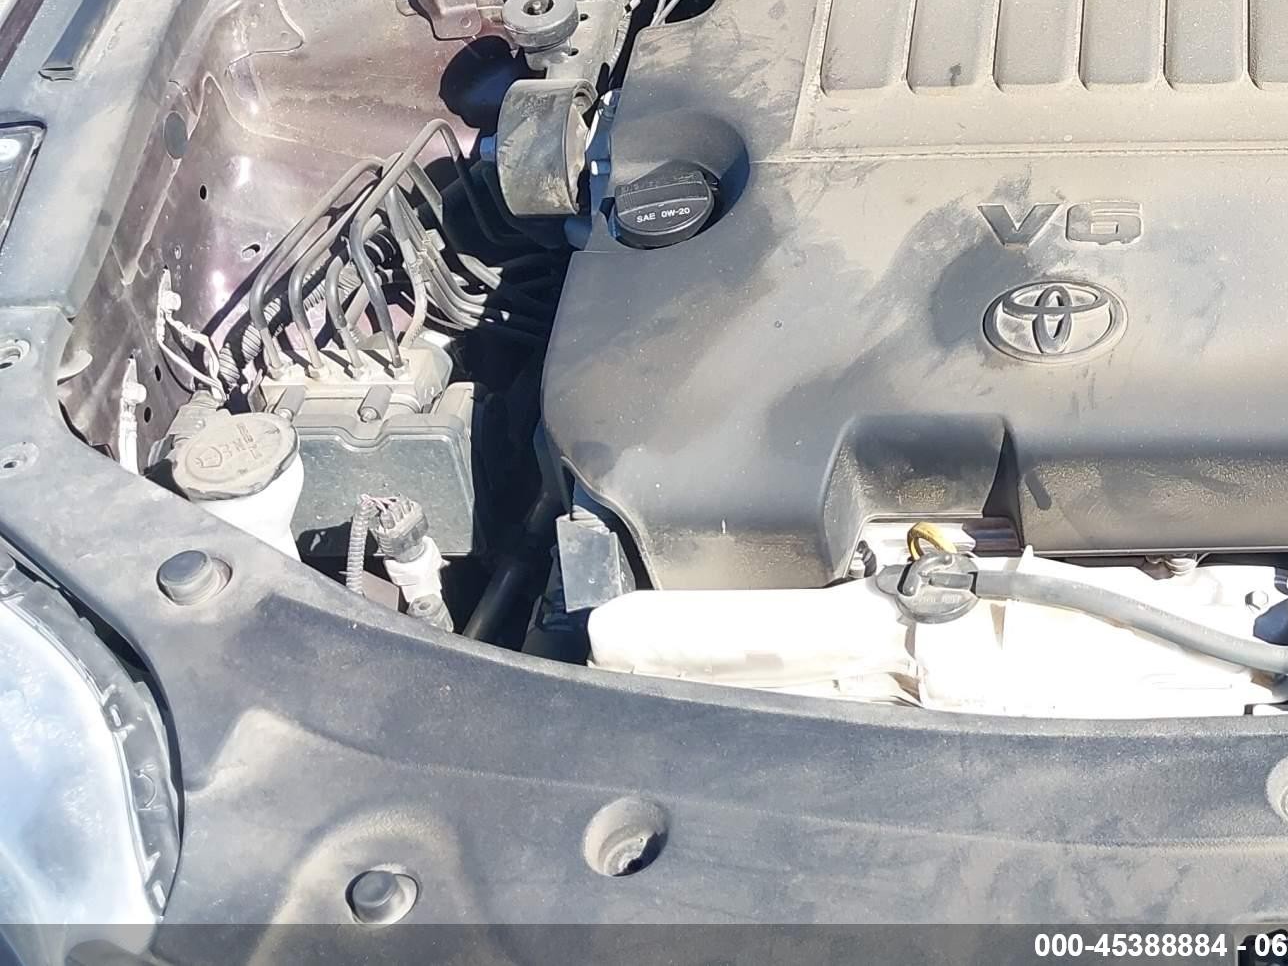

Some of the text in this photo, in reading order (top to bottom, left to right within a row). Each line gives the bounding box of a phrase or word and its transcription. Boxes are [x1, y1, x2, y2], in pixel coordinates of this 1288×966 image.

[636, 206, 691, 224] SAE 0W-20
[976, 200, 1144, 246] V6
